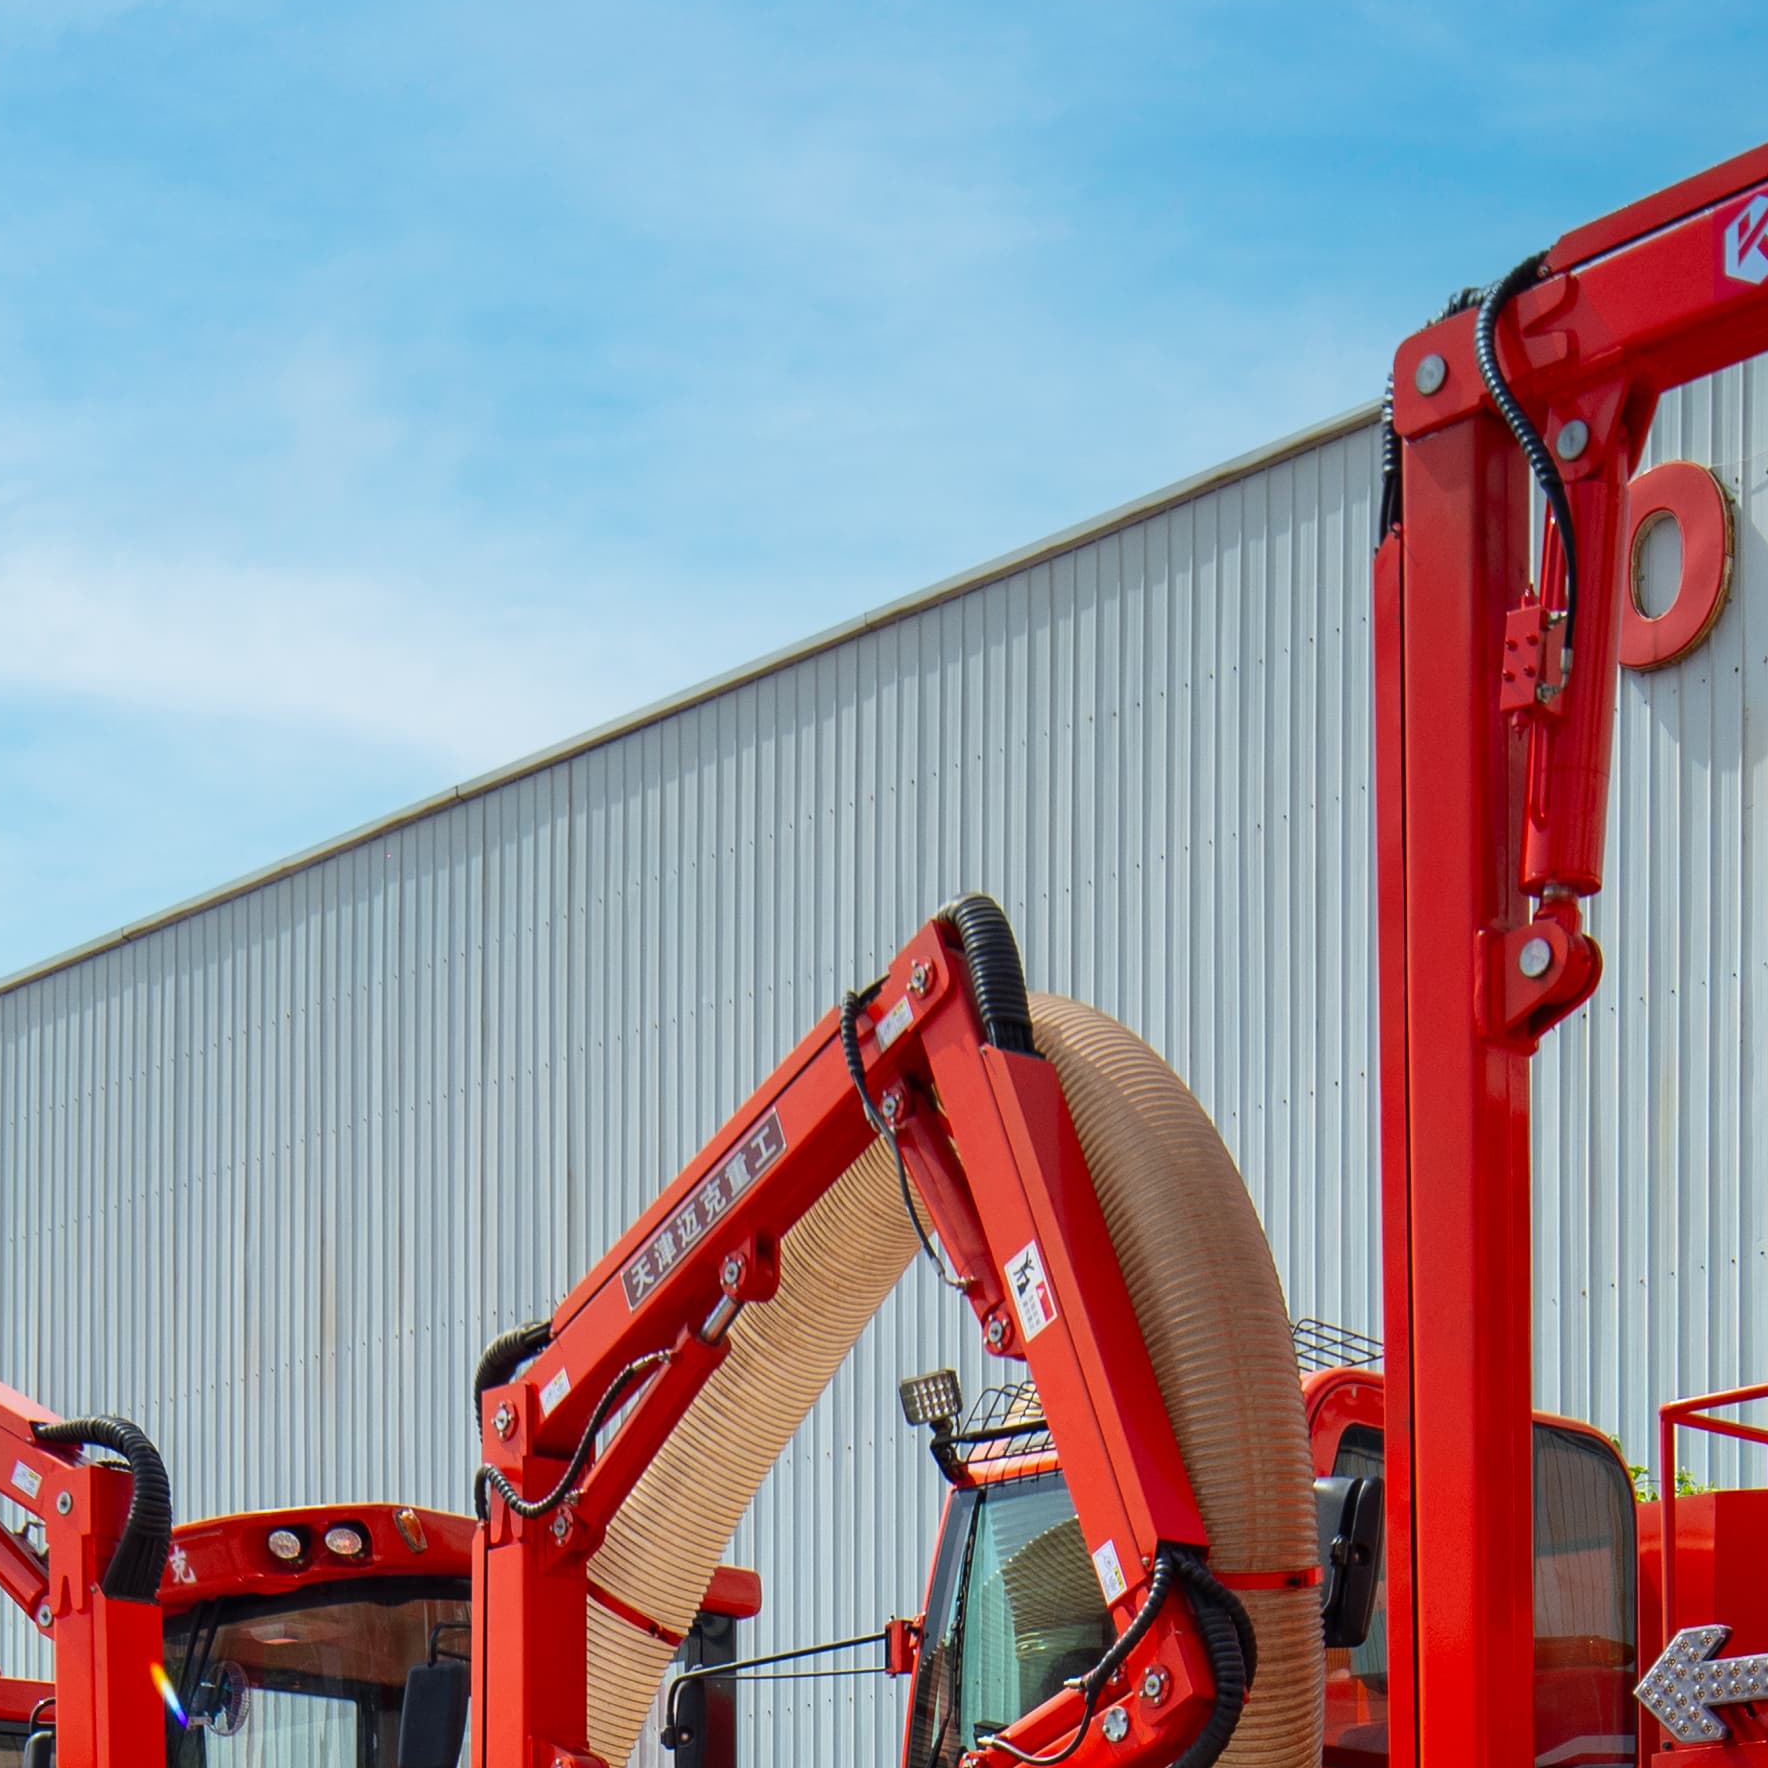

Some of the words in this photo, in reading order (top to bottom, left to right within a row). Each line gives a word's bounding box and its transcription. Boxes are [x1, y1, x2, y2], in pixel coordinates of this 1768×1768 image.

[631, 1126, 777, 1298] 天津迈克重工
[168, 1543, 197, 1583] 克
